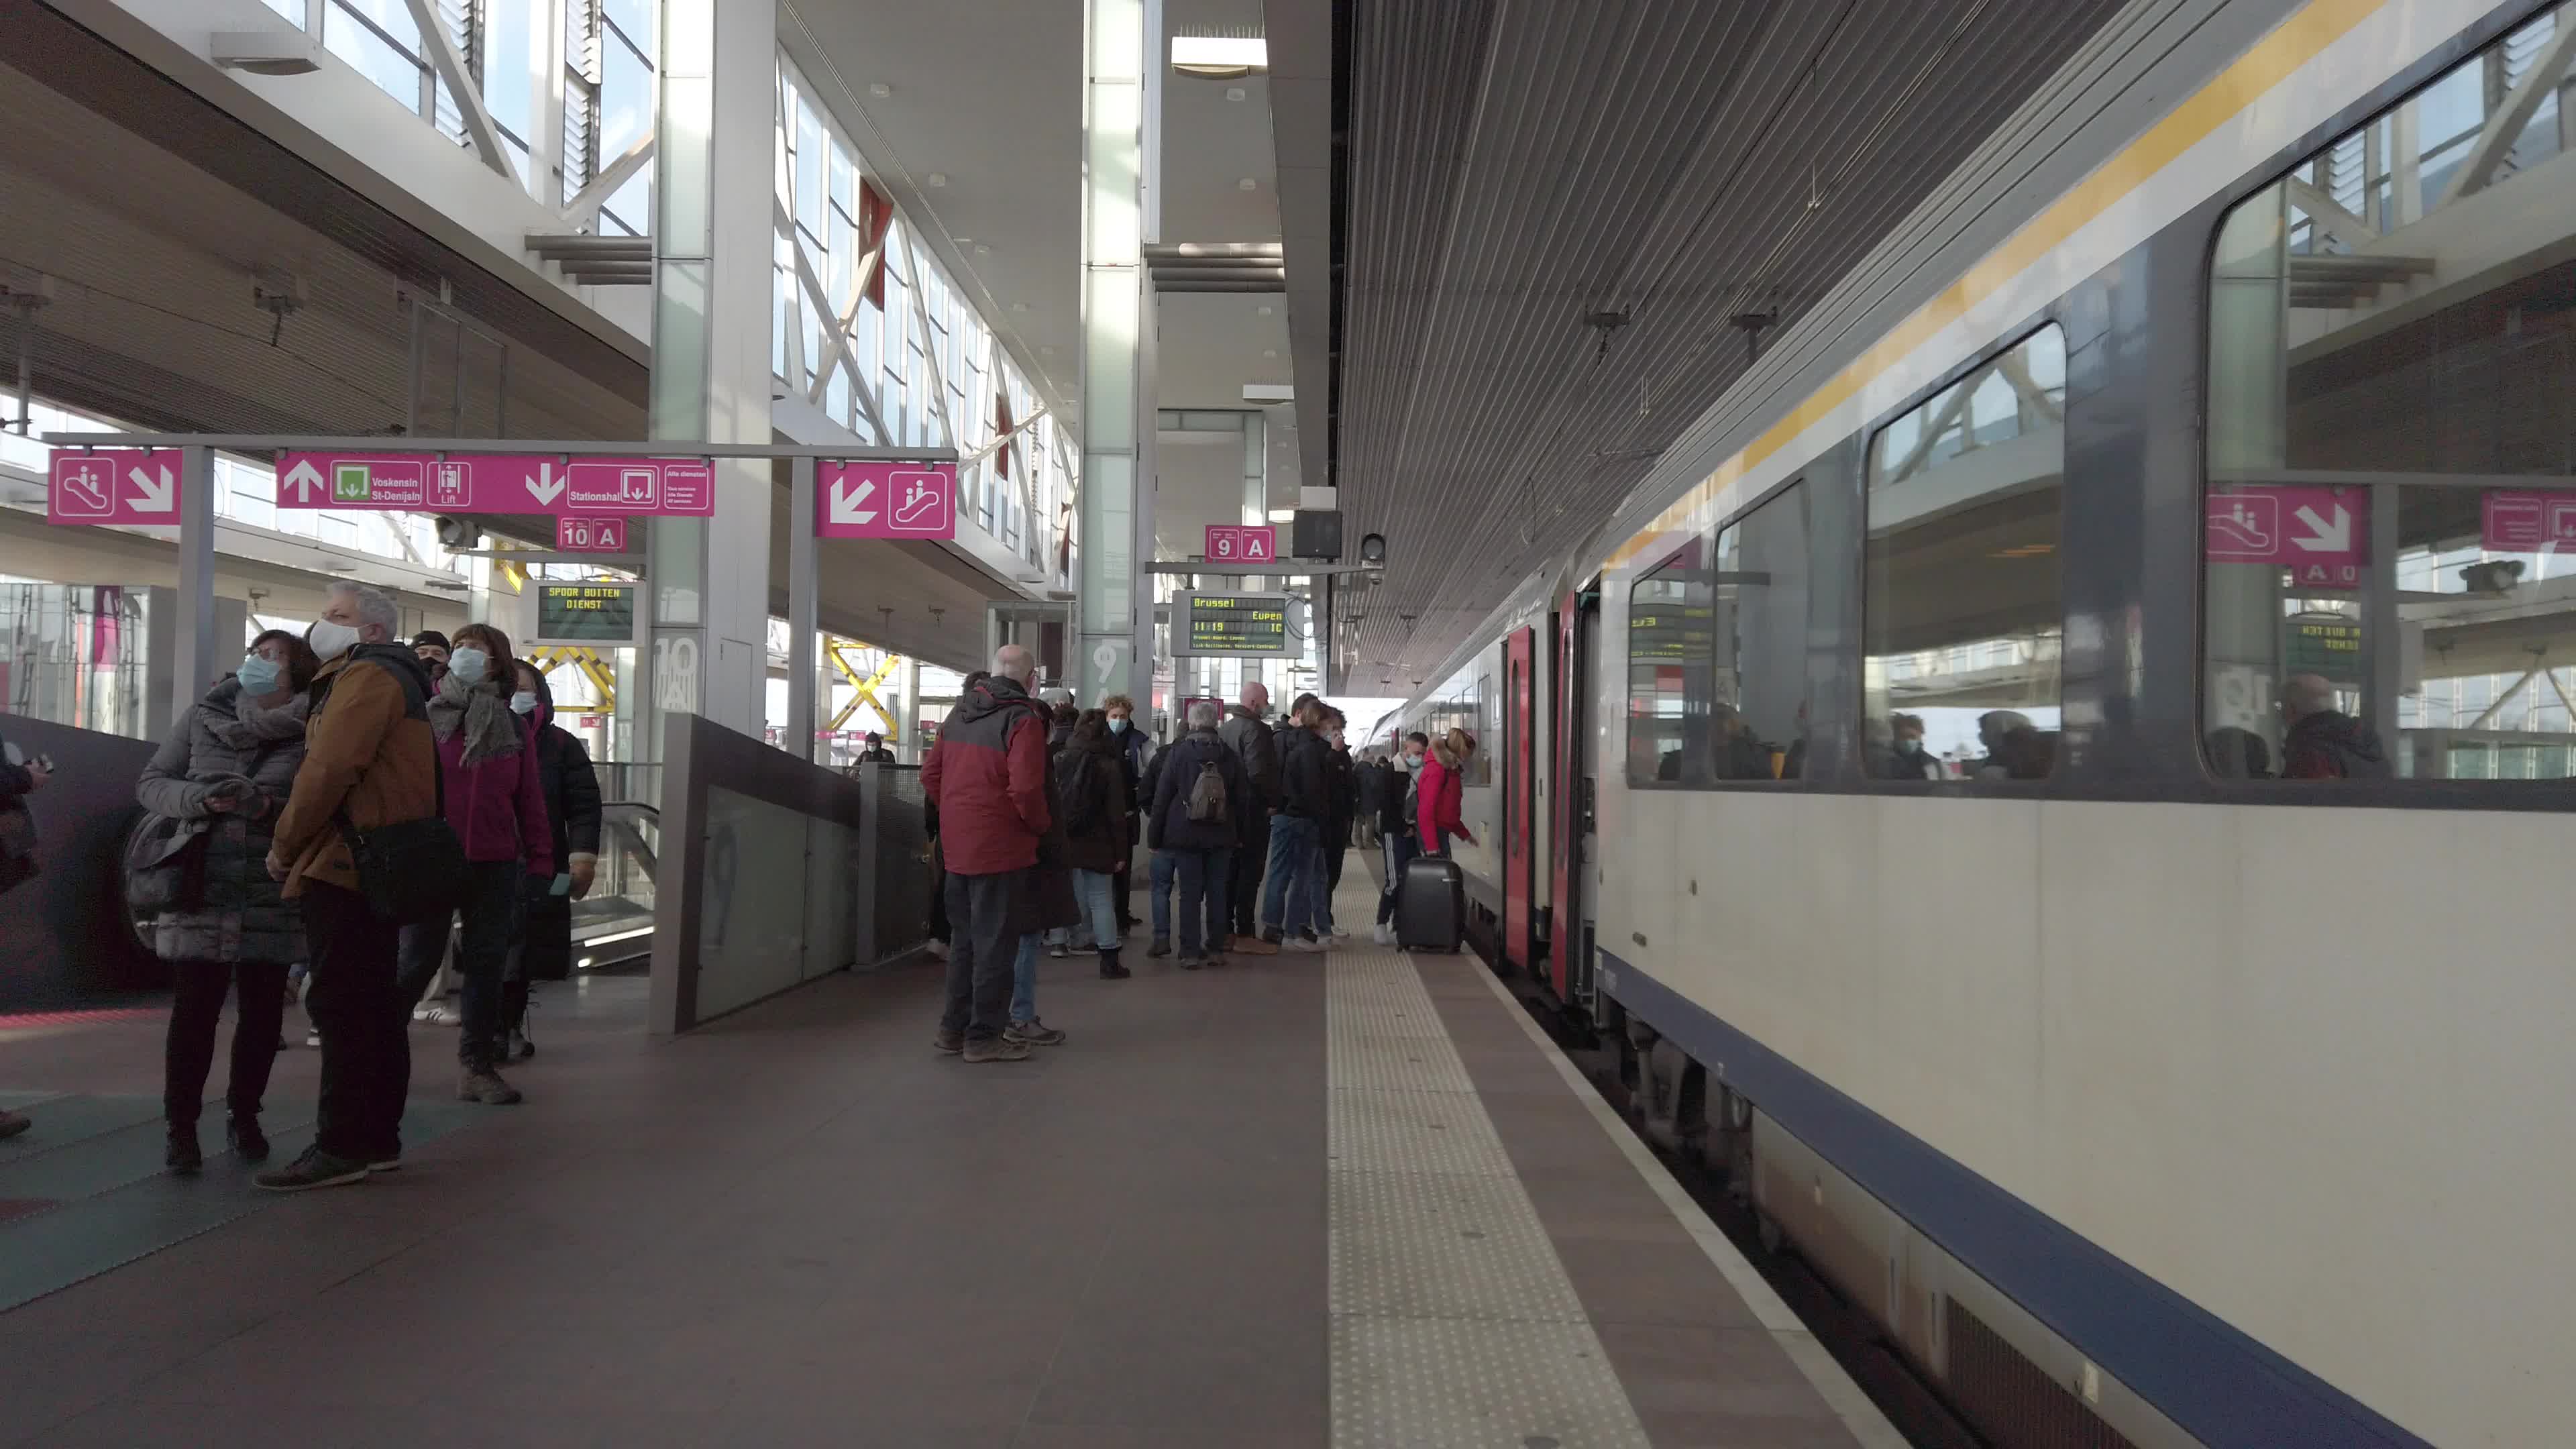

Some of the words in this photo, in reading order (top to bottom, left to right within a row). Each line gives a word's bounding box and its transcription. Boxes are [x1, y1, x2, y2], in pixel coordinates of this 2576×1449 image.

[372, 478, 417, 487] Voskensln
[372, 491, 420, 502] St-Denijsln
[441, 495, 455, 504] Lift
[570, 491, 620, 502] Stationshal
[565, 528, 588, 545] 10
[600, 528, 615, 545] A
[1218, 539, 1230, 555] 9
[1248, 539, 1264, 556] A
[549, 588, 579, 596] SPOOR
[584, 588, 621, 597] BUITEN
[566, 600, 602, 609] DIENST
[1194, 598, 1234, 607] Brussel
[1252, 611, 1282, 621] Eupen
[1271, 623, 1282, 633] IC
[655, 637, 698, 676] 10
[1093, 646, 1117, 684] 9
